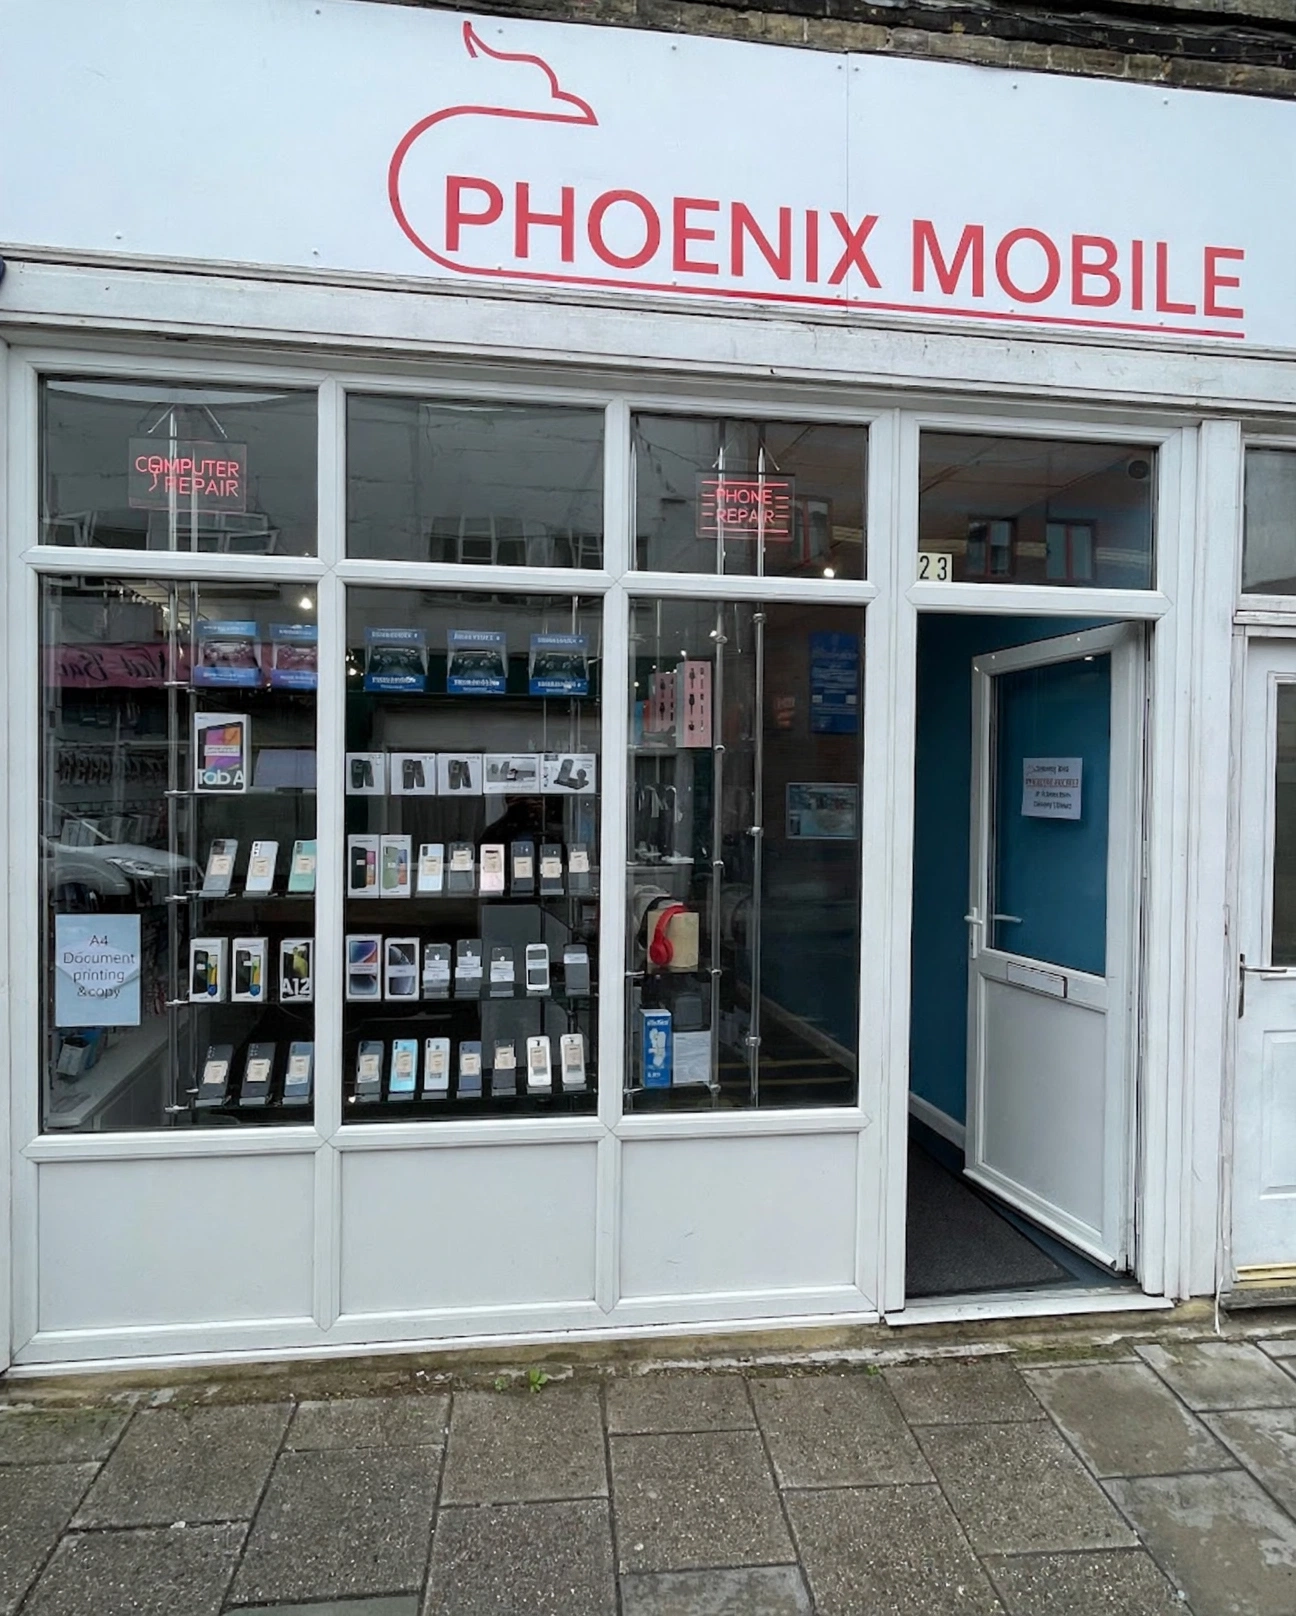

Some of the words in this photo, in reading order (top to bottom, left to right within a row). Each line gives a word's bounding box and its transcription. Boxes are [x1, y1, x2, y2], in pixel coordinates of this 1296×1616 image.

[446, 175, 882, 289] PHOENIX
[911, 219, 1246, 319] MOBILE
[135, 455, 240, 478] COMPUTER
[165, 476, 239, 498] REPAIR
[715, 488, 773, 505] PHONE
[716, 508, 775, 524] REPAR
[919, 555, 947, 581] 23
[197, 769, 231, 785] Tab
[89, 935, 109, 946] A4
[63, 952, 135, 964] Document
[73, 968, 125, 983] printing
[77, 985, 121, 999] &copy
[282, 978, 310, 996] A12
